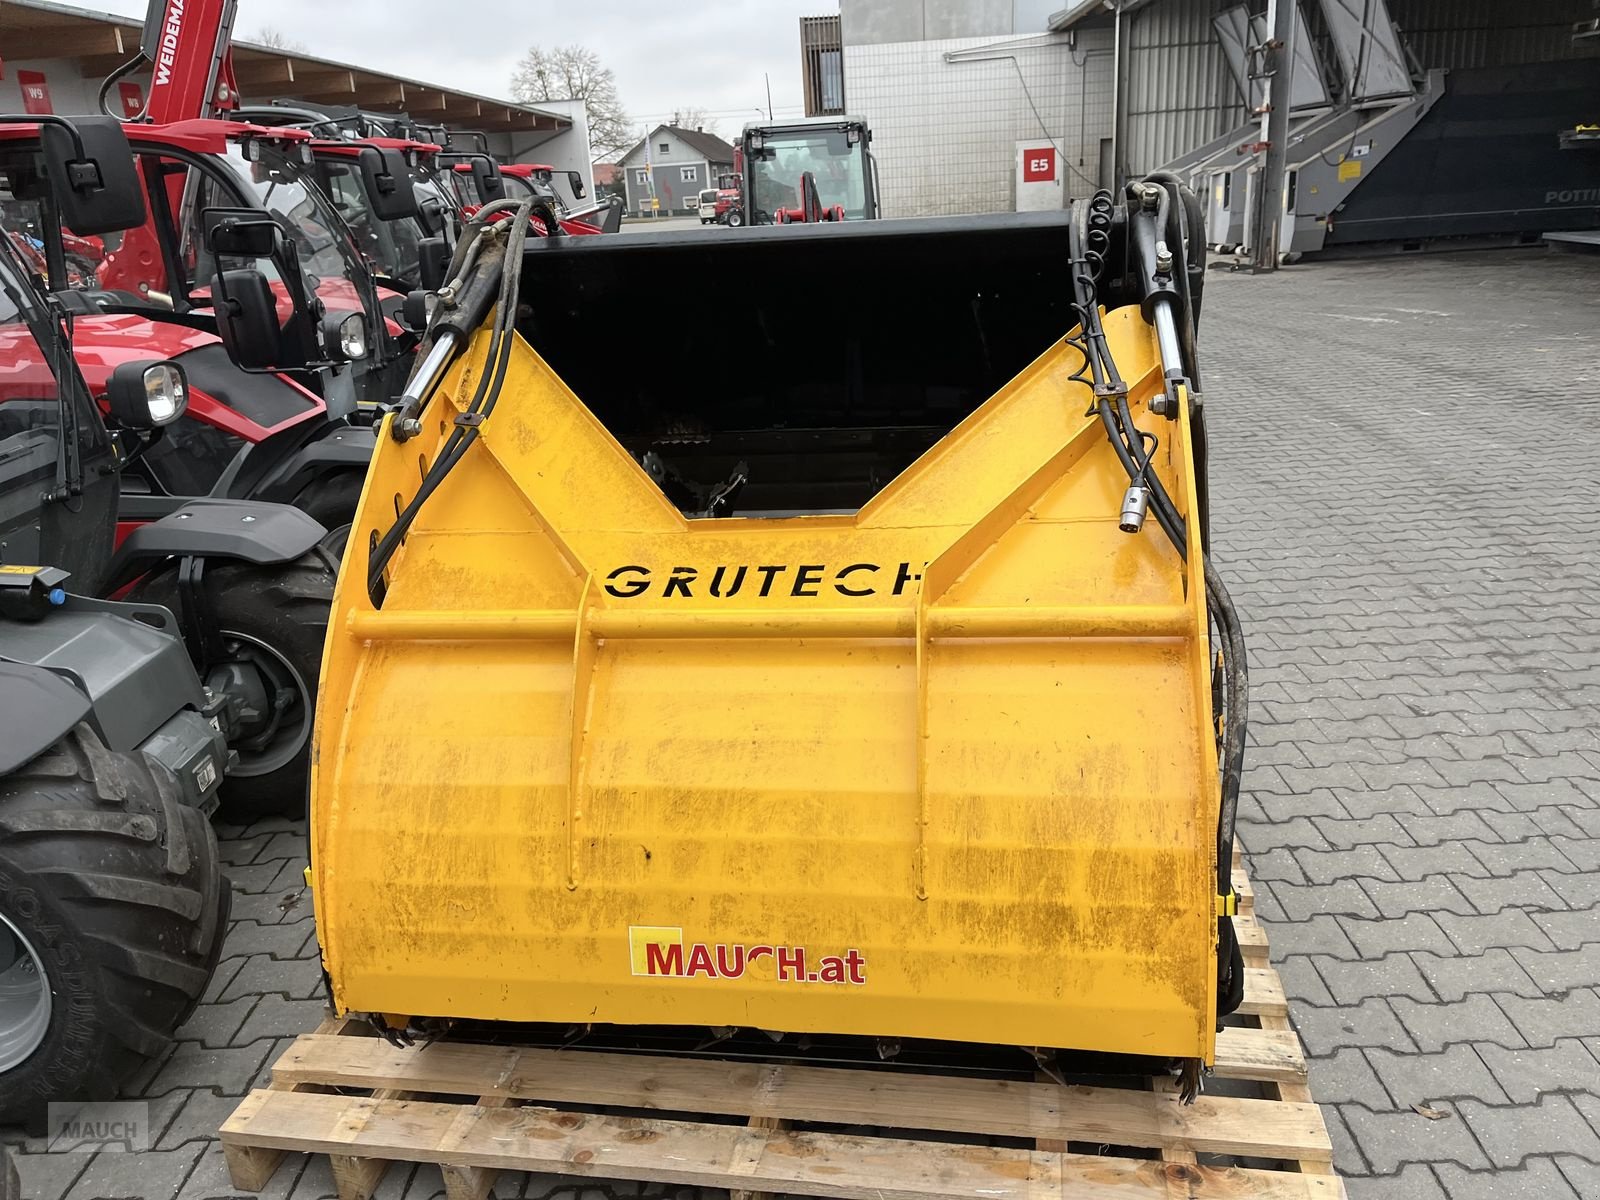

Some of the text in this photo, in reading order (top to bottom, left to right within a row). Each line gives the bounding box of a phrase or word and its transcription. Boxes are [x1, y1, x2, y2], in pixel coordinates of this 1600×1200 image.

[28, 87, 43, 100] W9
[1030, 158, 1049, 172] E5
[604, 561, 928, 598] GRUTECH
